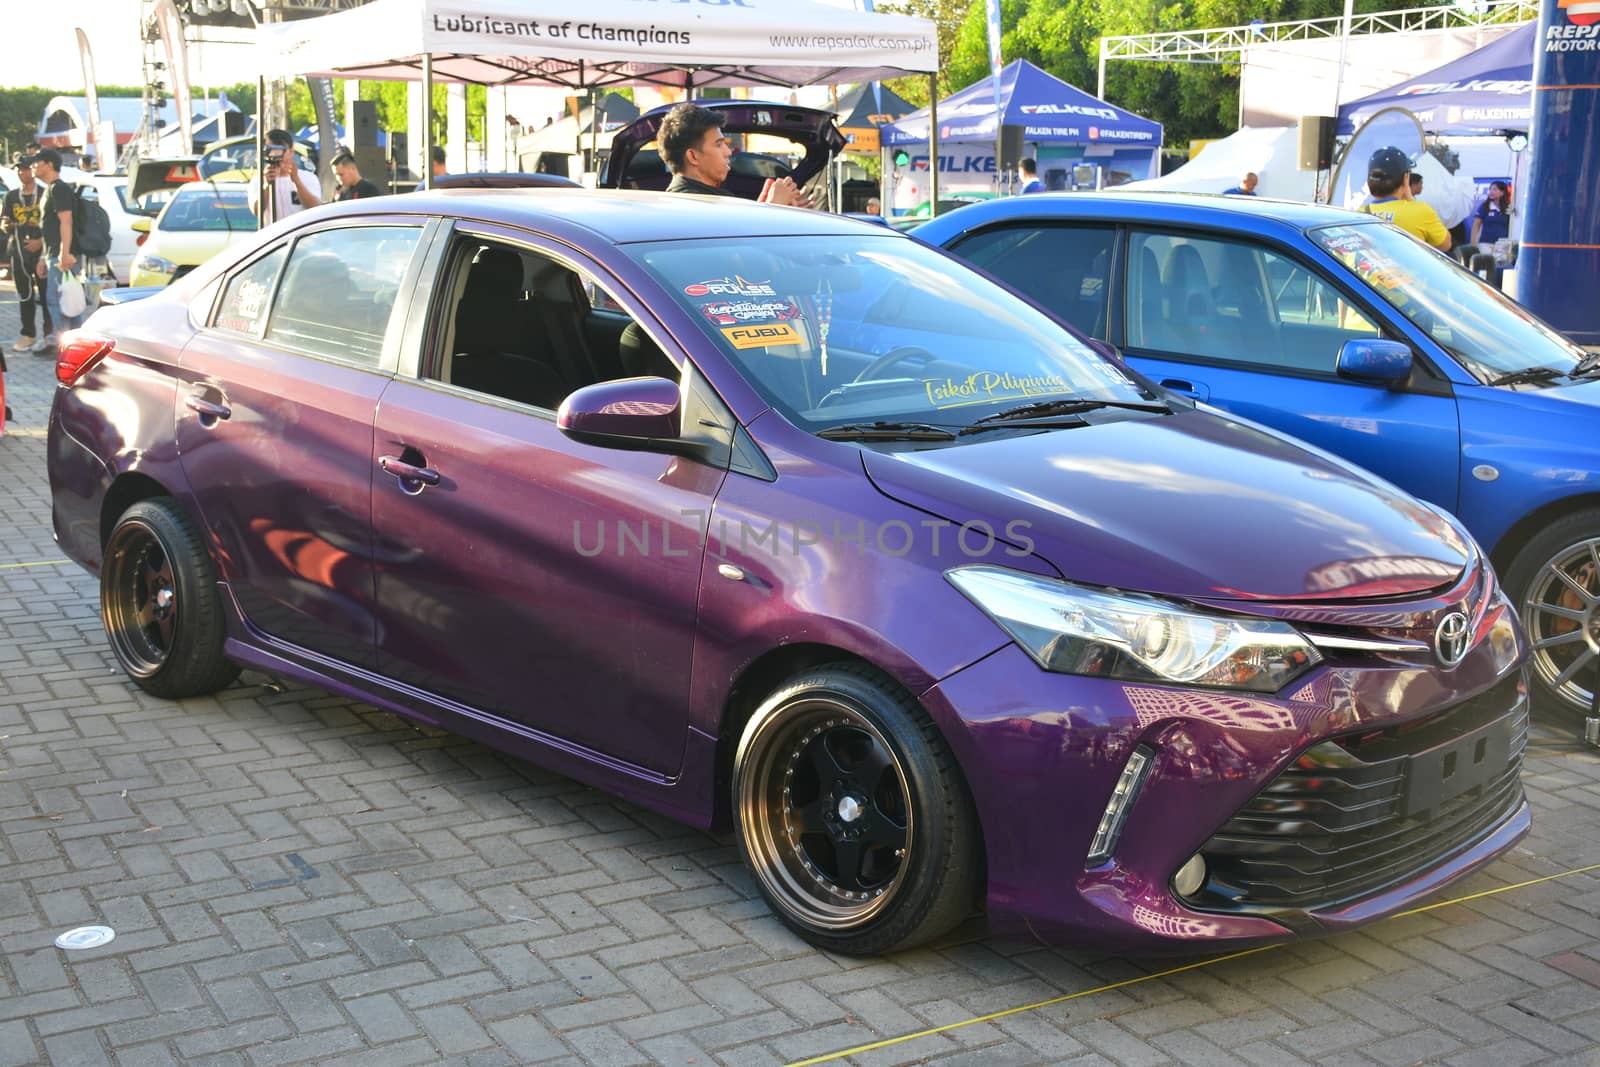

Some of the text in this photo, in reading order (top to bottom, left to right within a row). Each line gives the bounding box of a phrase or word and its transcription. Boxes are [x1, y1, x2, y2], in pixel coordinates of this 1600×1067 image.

[433, 14, 690, 46] Lubricant of Champions
[1545, 39, 1596, 52] MOTOR
[1020, 104, 1119, 120] FALKEN
[1025, 126, 1079, 136] FALKEN TIRE PH
[910, 155, 999, 173] FALKE
[731, 327, 789, 340] FUBU
[921, 375, 978, 406] Tsikot
[974, 370, 1065, 397] Pilipinas
